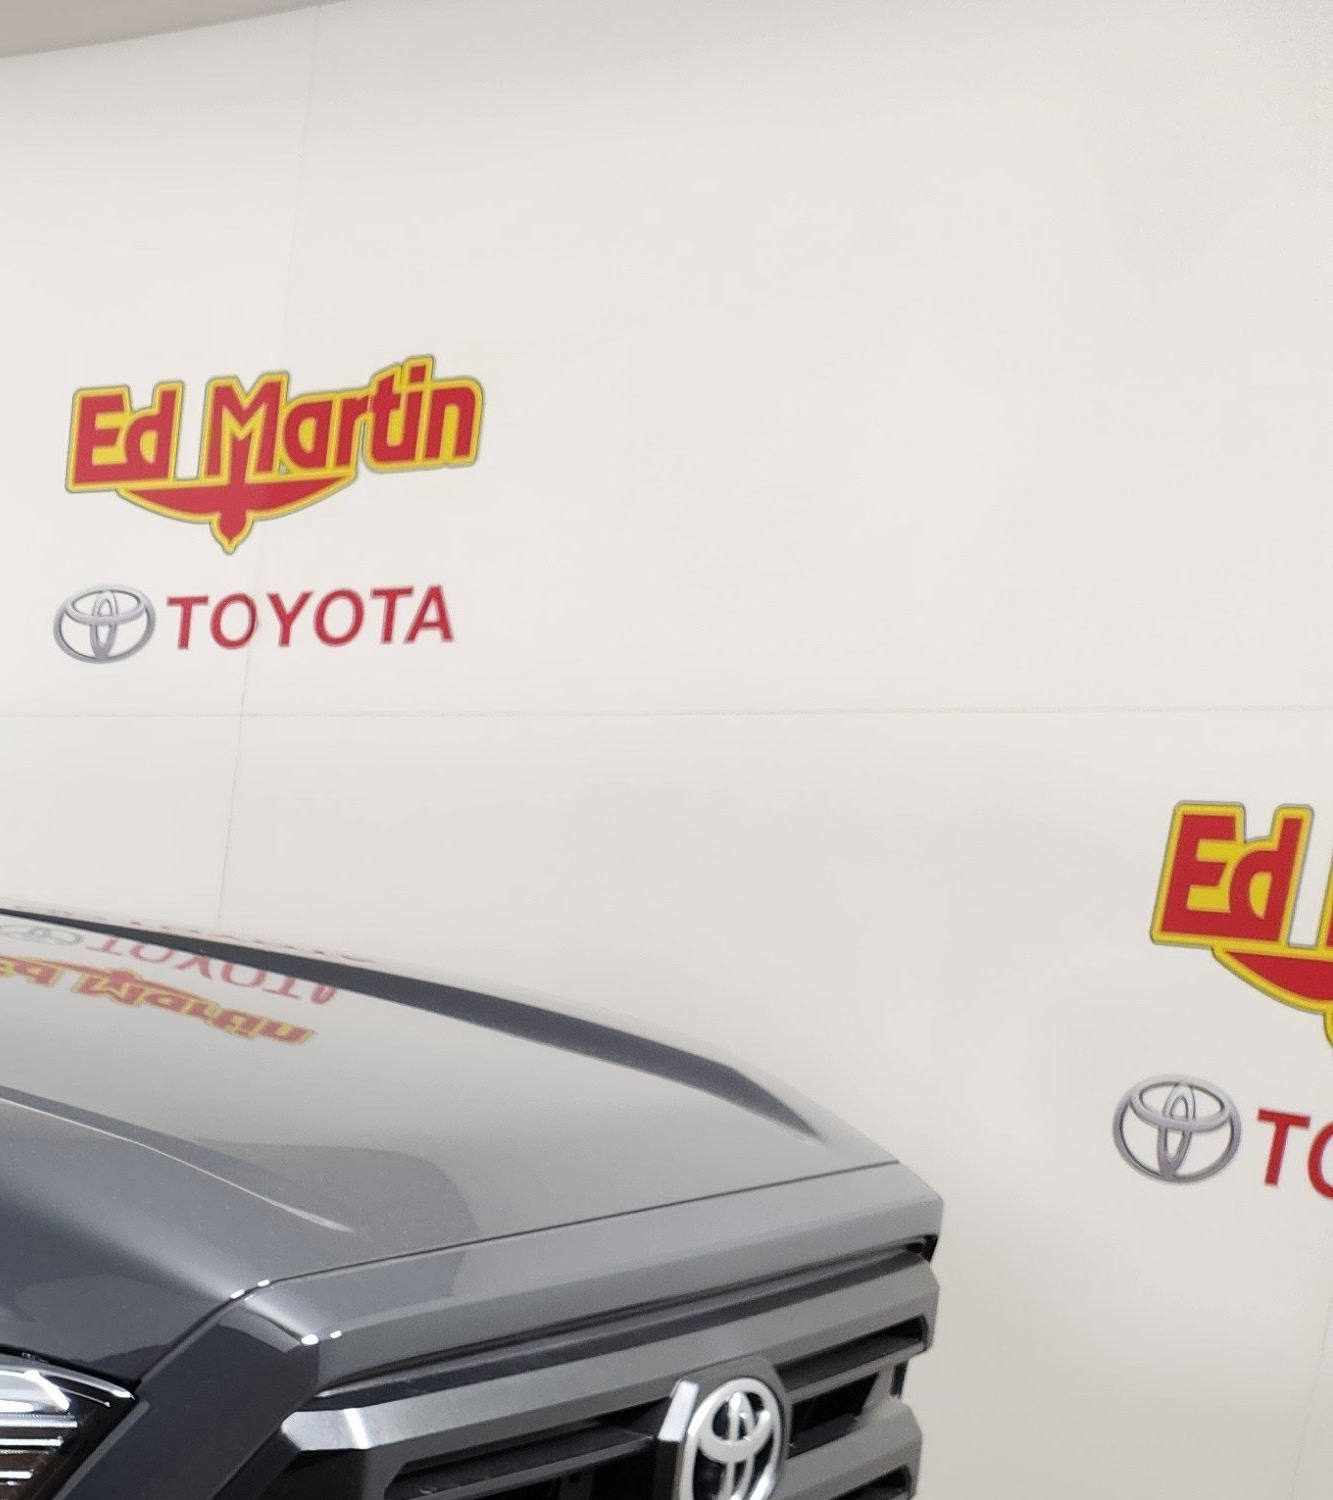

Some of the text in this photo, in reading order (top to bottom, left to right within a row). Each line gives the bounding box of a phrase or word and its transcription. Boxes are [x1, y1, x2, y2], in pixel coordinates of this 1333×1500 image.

[70, 360, 482, 488] Ed Martin
[167, 585, 454, 650] TOYOTA
[1155, 808, 1308, 944] Ed
